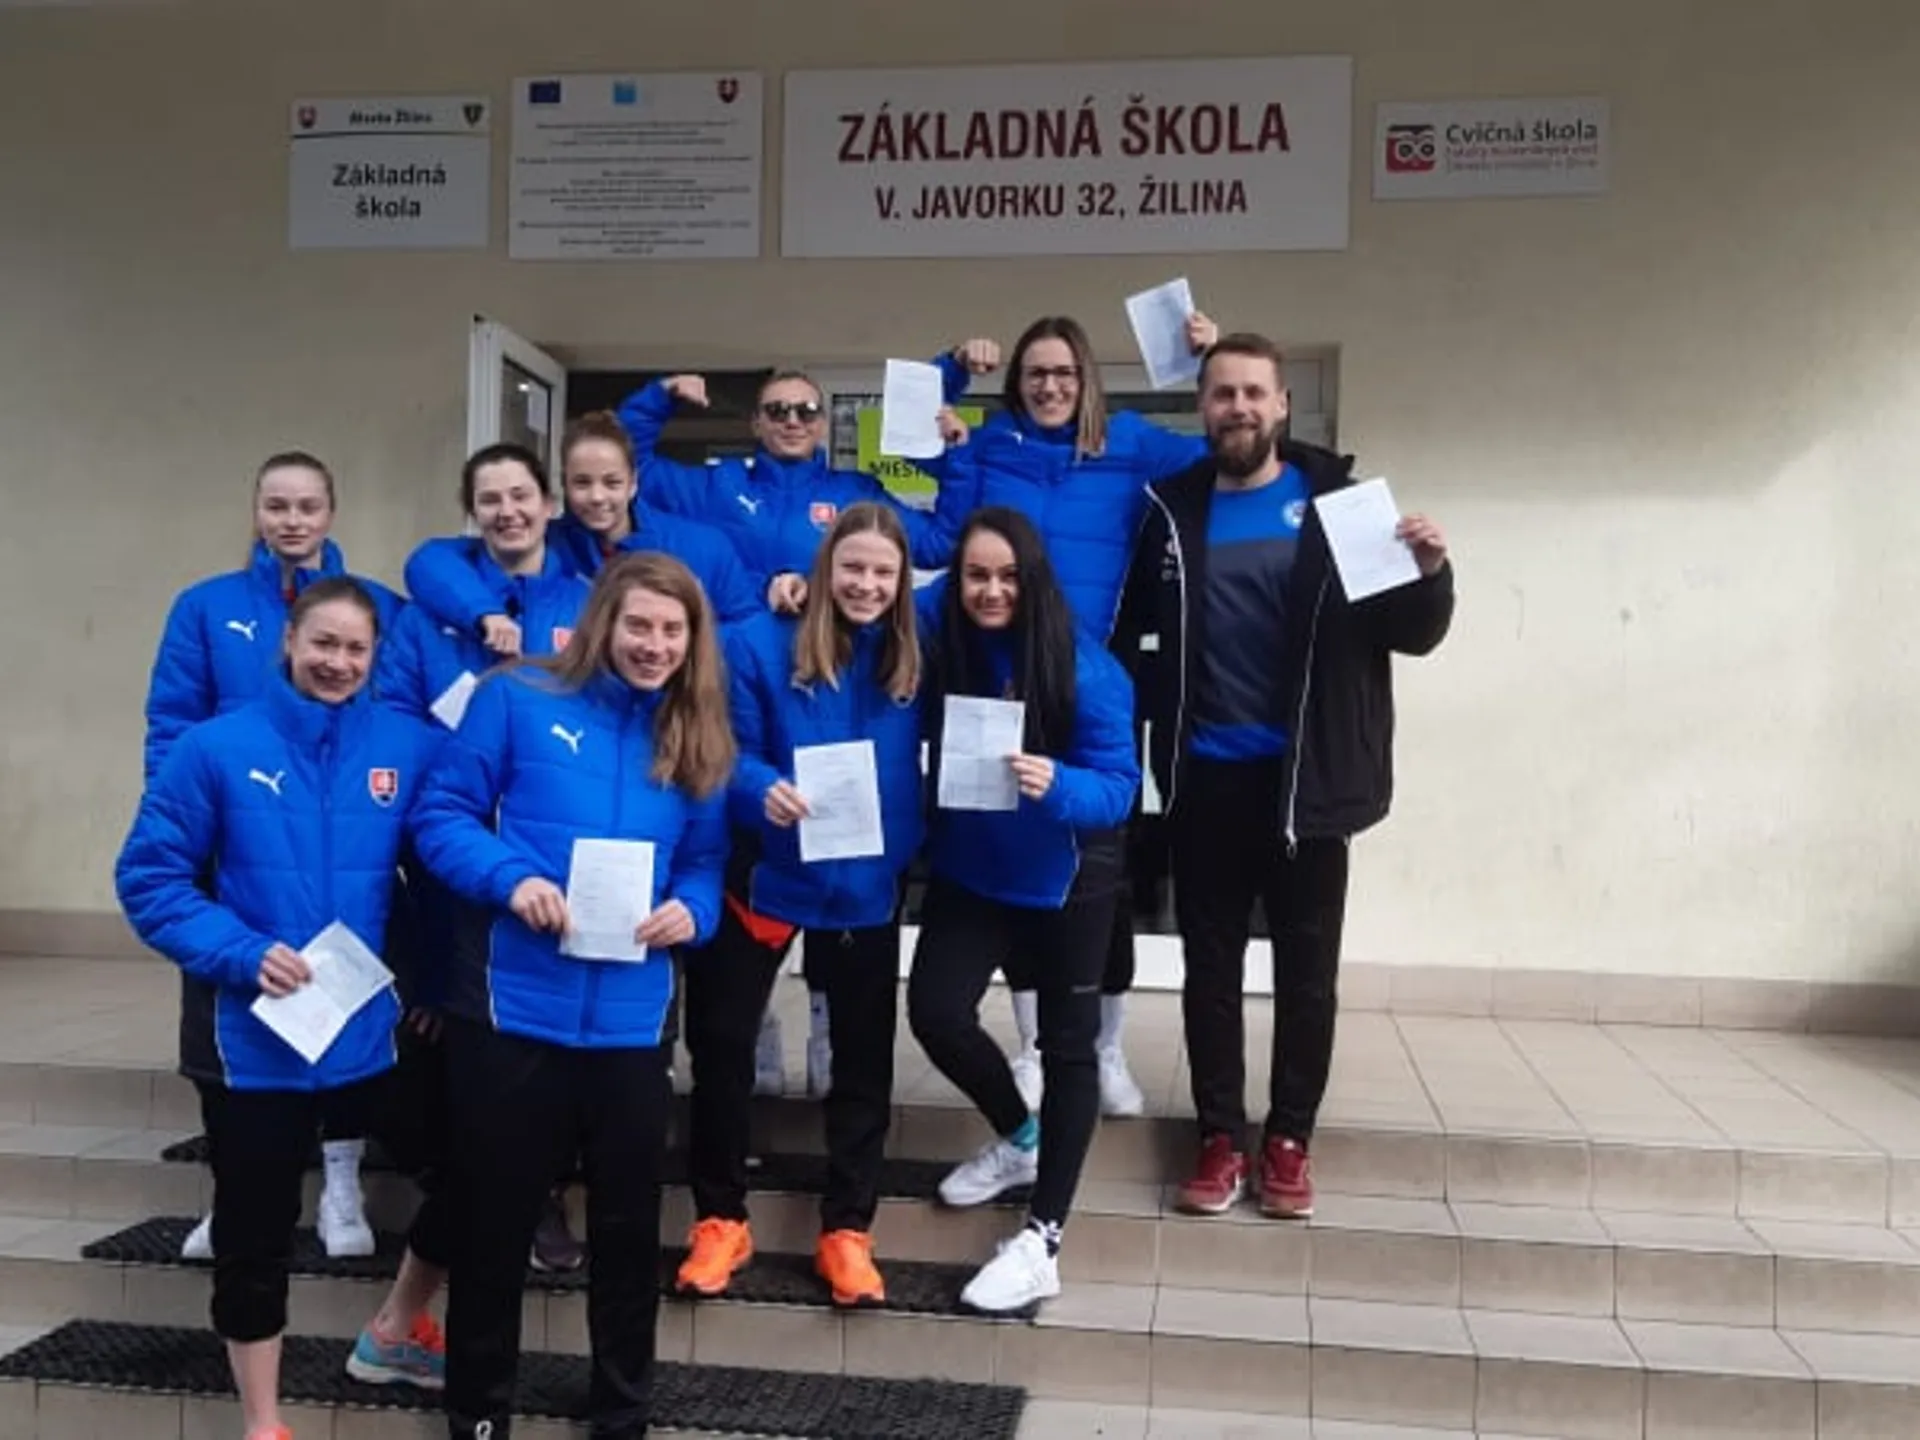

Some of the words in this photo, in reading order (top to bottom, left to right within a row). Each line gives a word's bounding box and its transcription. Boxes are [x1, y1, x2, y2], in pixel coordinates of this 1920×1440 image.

[837, 96, 1102, 164] ZÁKLADNÁ
[1119, 93, 1291, 158] ŠKOLA
[1445, 120, 1526, 144] Cvičná
[1532, 118, 1598, 143] škola
[332, 162, 447, 187] Základná
[355, 194, 422, 219] škola
[875, 186, 902, 221] V.
[911, 183, 1065, 220] JAVORKU
[1076, 182, 1127, 220] 32,
[1138, 174, 1248, 216] ŽILINA
